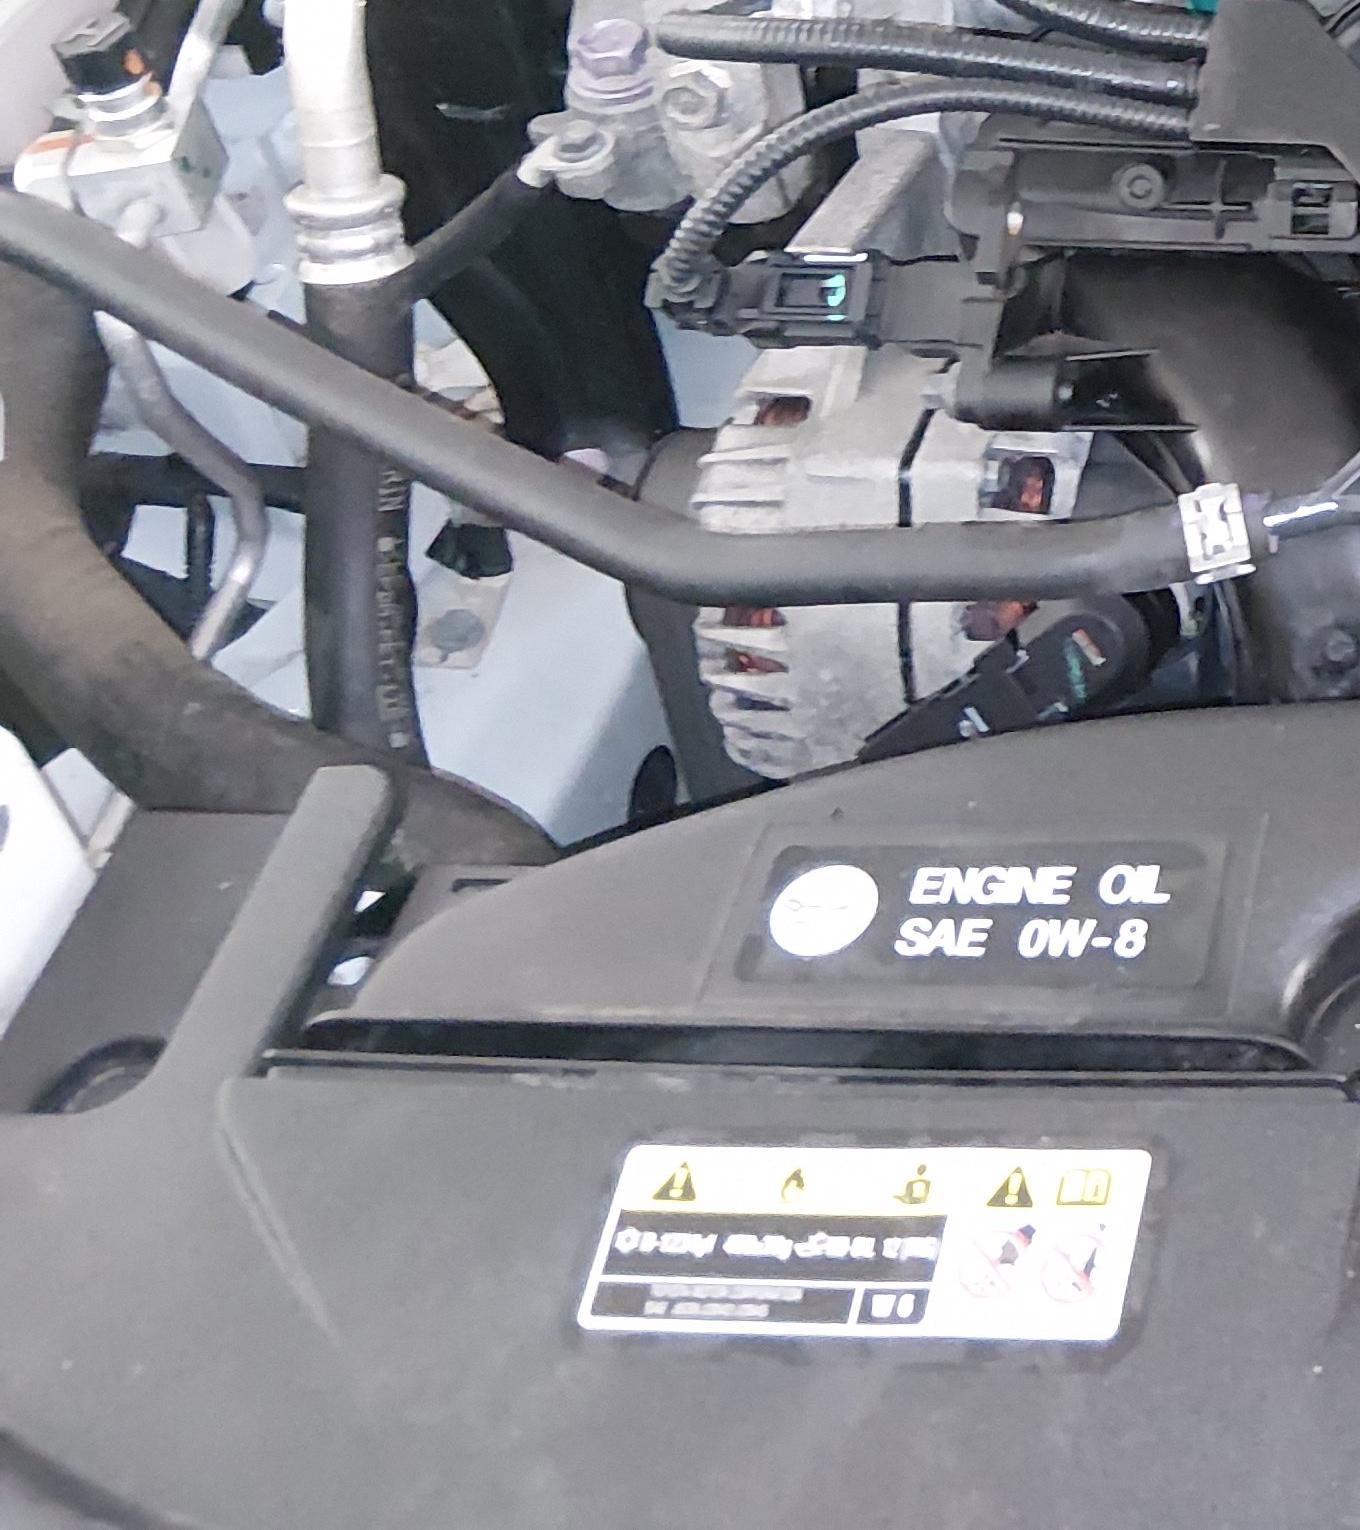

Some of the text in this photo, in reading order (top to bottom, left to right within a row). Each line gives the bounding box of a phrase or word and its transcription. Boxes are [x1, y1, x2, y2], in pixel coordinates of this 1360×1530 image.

[908, 864, 1170, 905] ENGINE OIL
[894, 918, 1149, 959] SAE 0W-8
